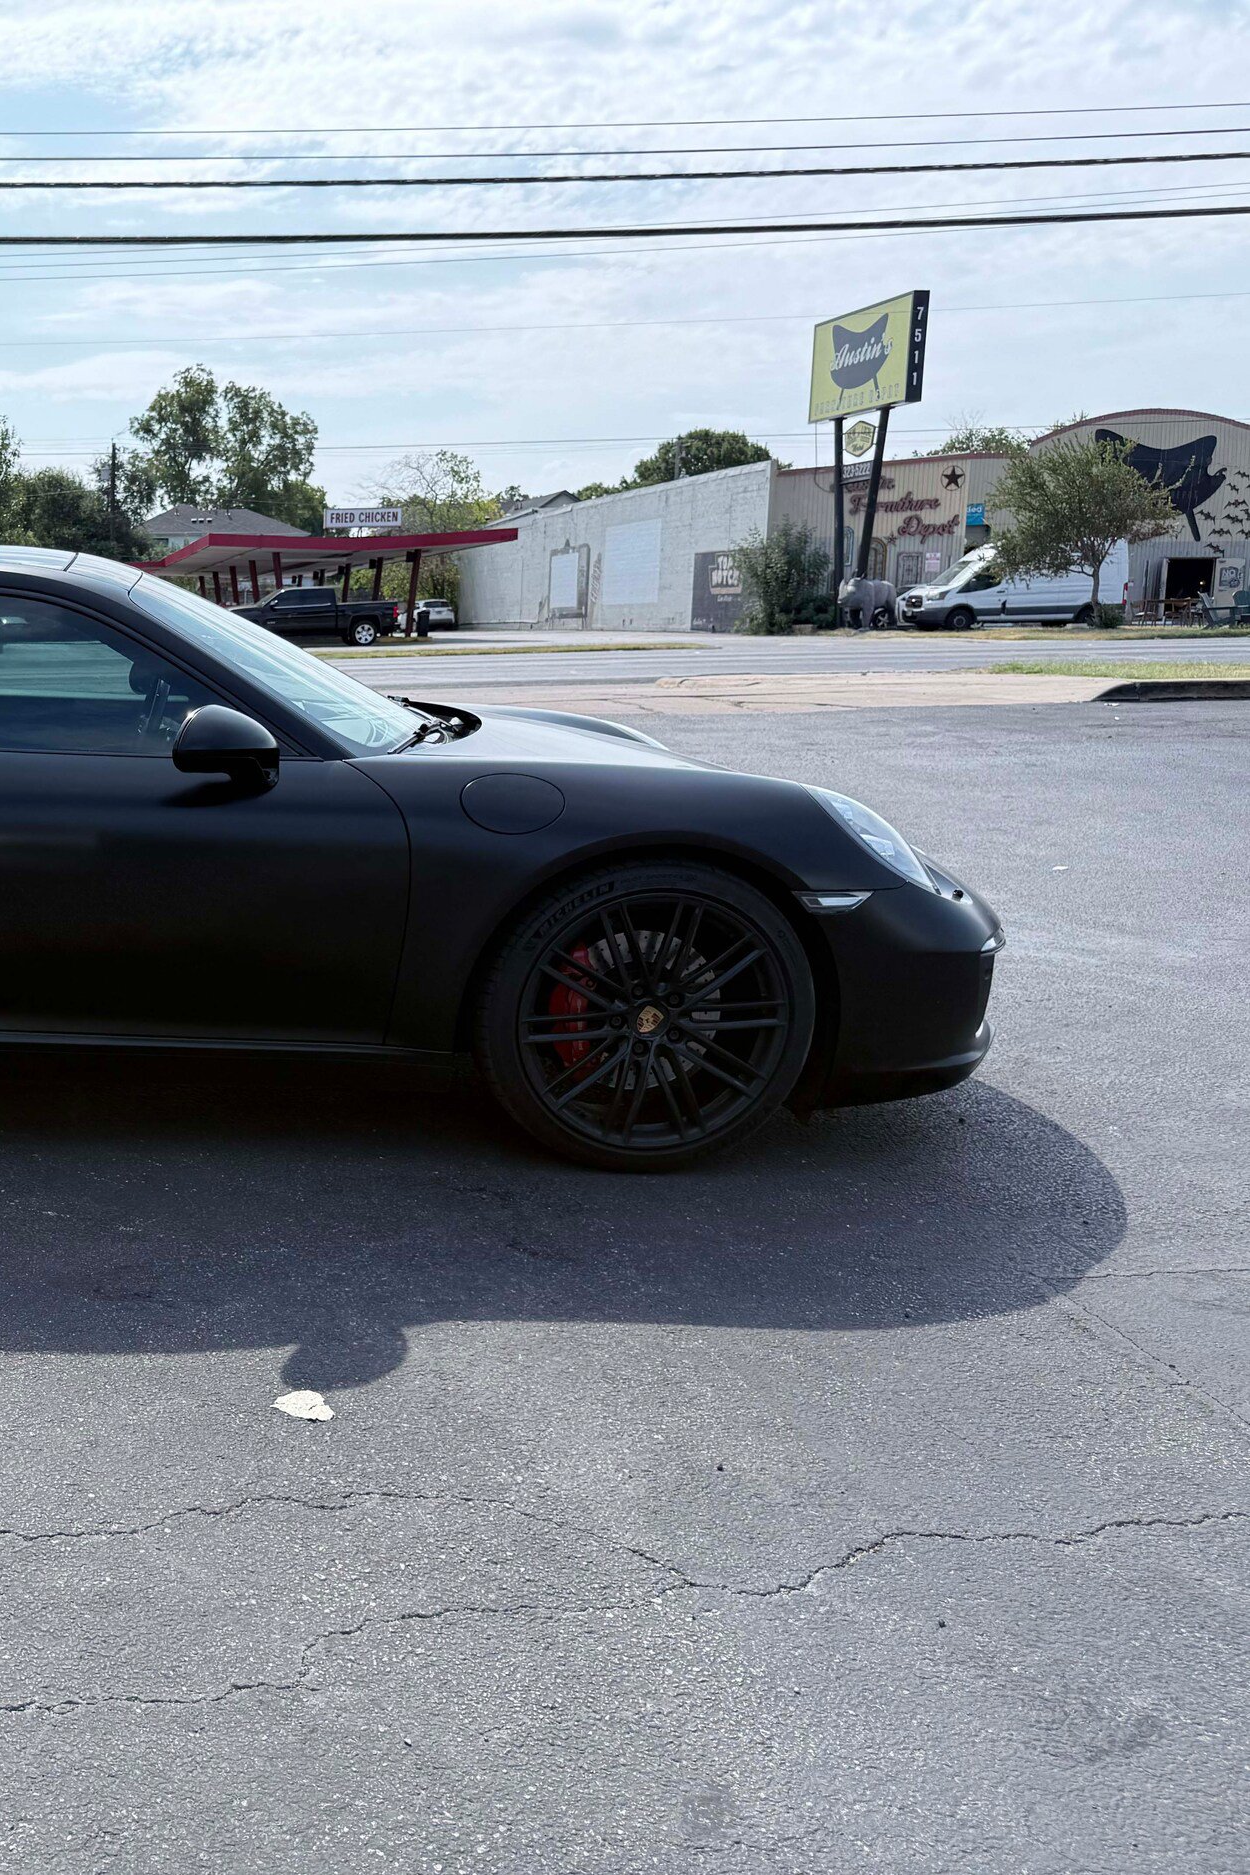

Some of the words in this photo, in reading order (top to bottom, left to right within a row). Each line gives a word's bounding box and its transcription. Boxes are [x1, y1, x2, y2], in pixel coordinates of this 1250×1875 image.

[830, 332, 894, 370] Austin's
[912, 306, 924, 386] 7511
[842, 462, 871, 479] 323-5222
[330, 512, 355, 524] FRIED
[358, 511, 399, 523] CHICKEN
[849, 491, 940, 515] Fniture
[898, 514, 960, 544] Depot
[536, 883, 612, 937] MICHELIN
